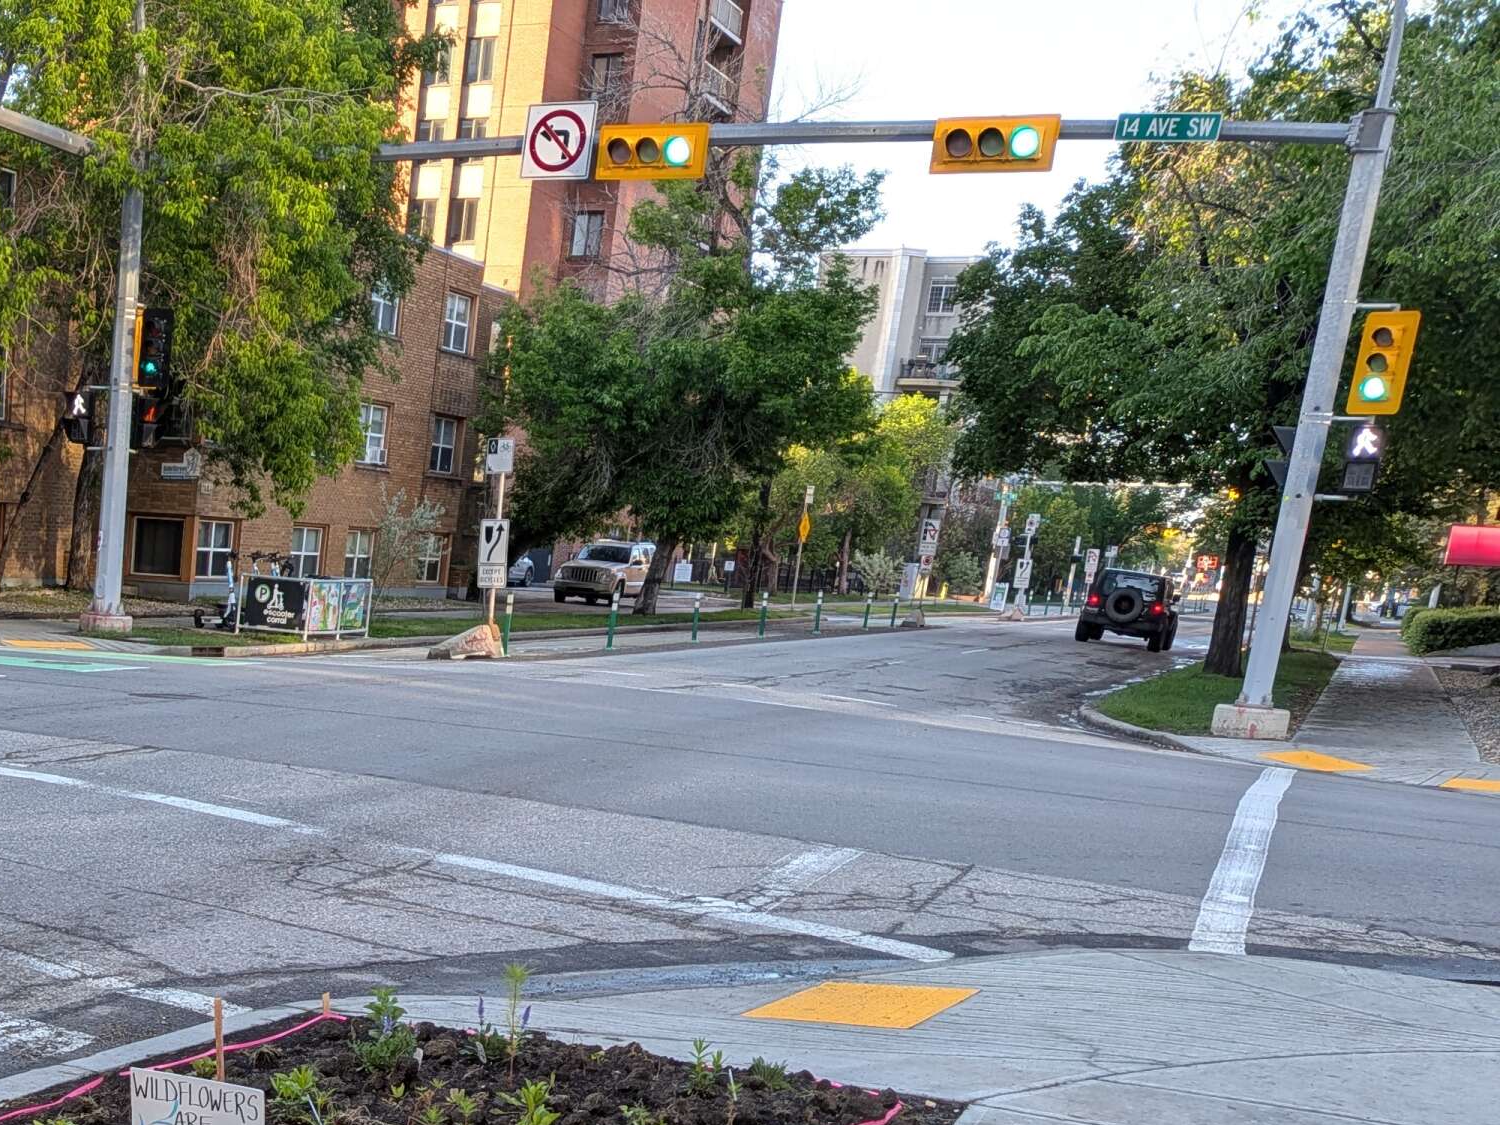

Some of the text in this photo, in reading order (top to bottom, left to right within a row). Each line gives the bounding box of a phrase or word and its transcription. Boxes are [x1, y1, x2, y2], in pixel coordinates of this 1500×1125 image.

[1122, 117, 1217, 137] 14 AVE SW
[267, 616, 287, 625] corral
[132, 1072, 258, 1124] WILDFLOWERS
